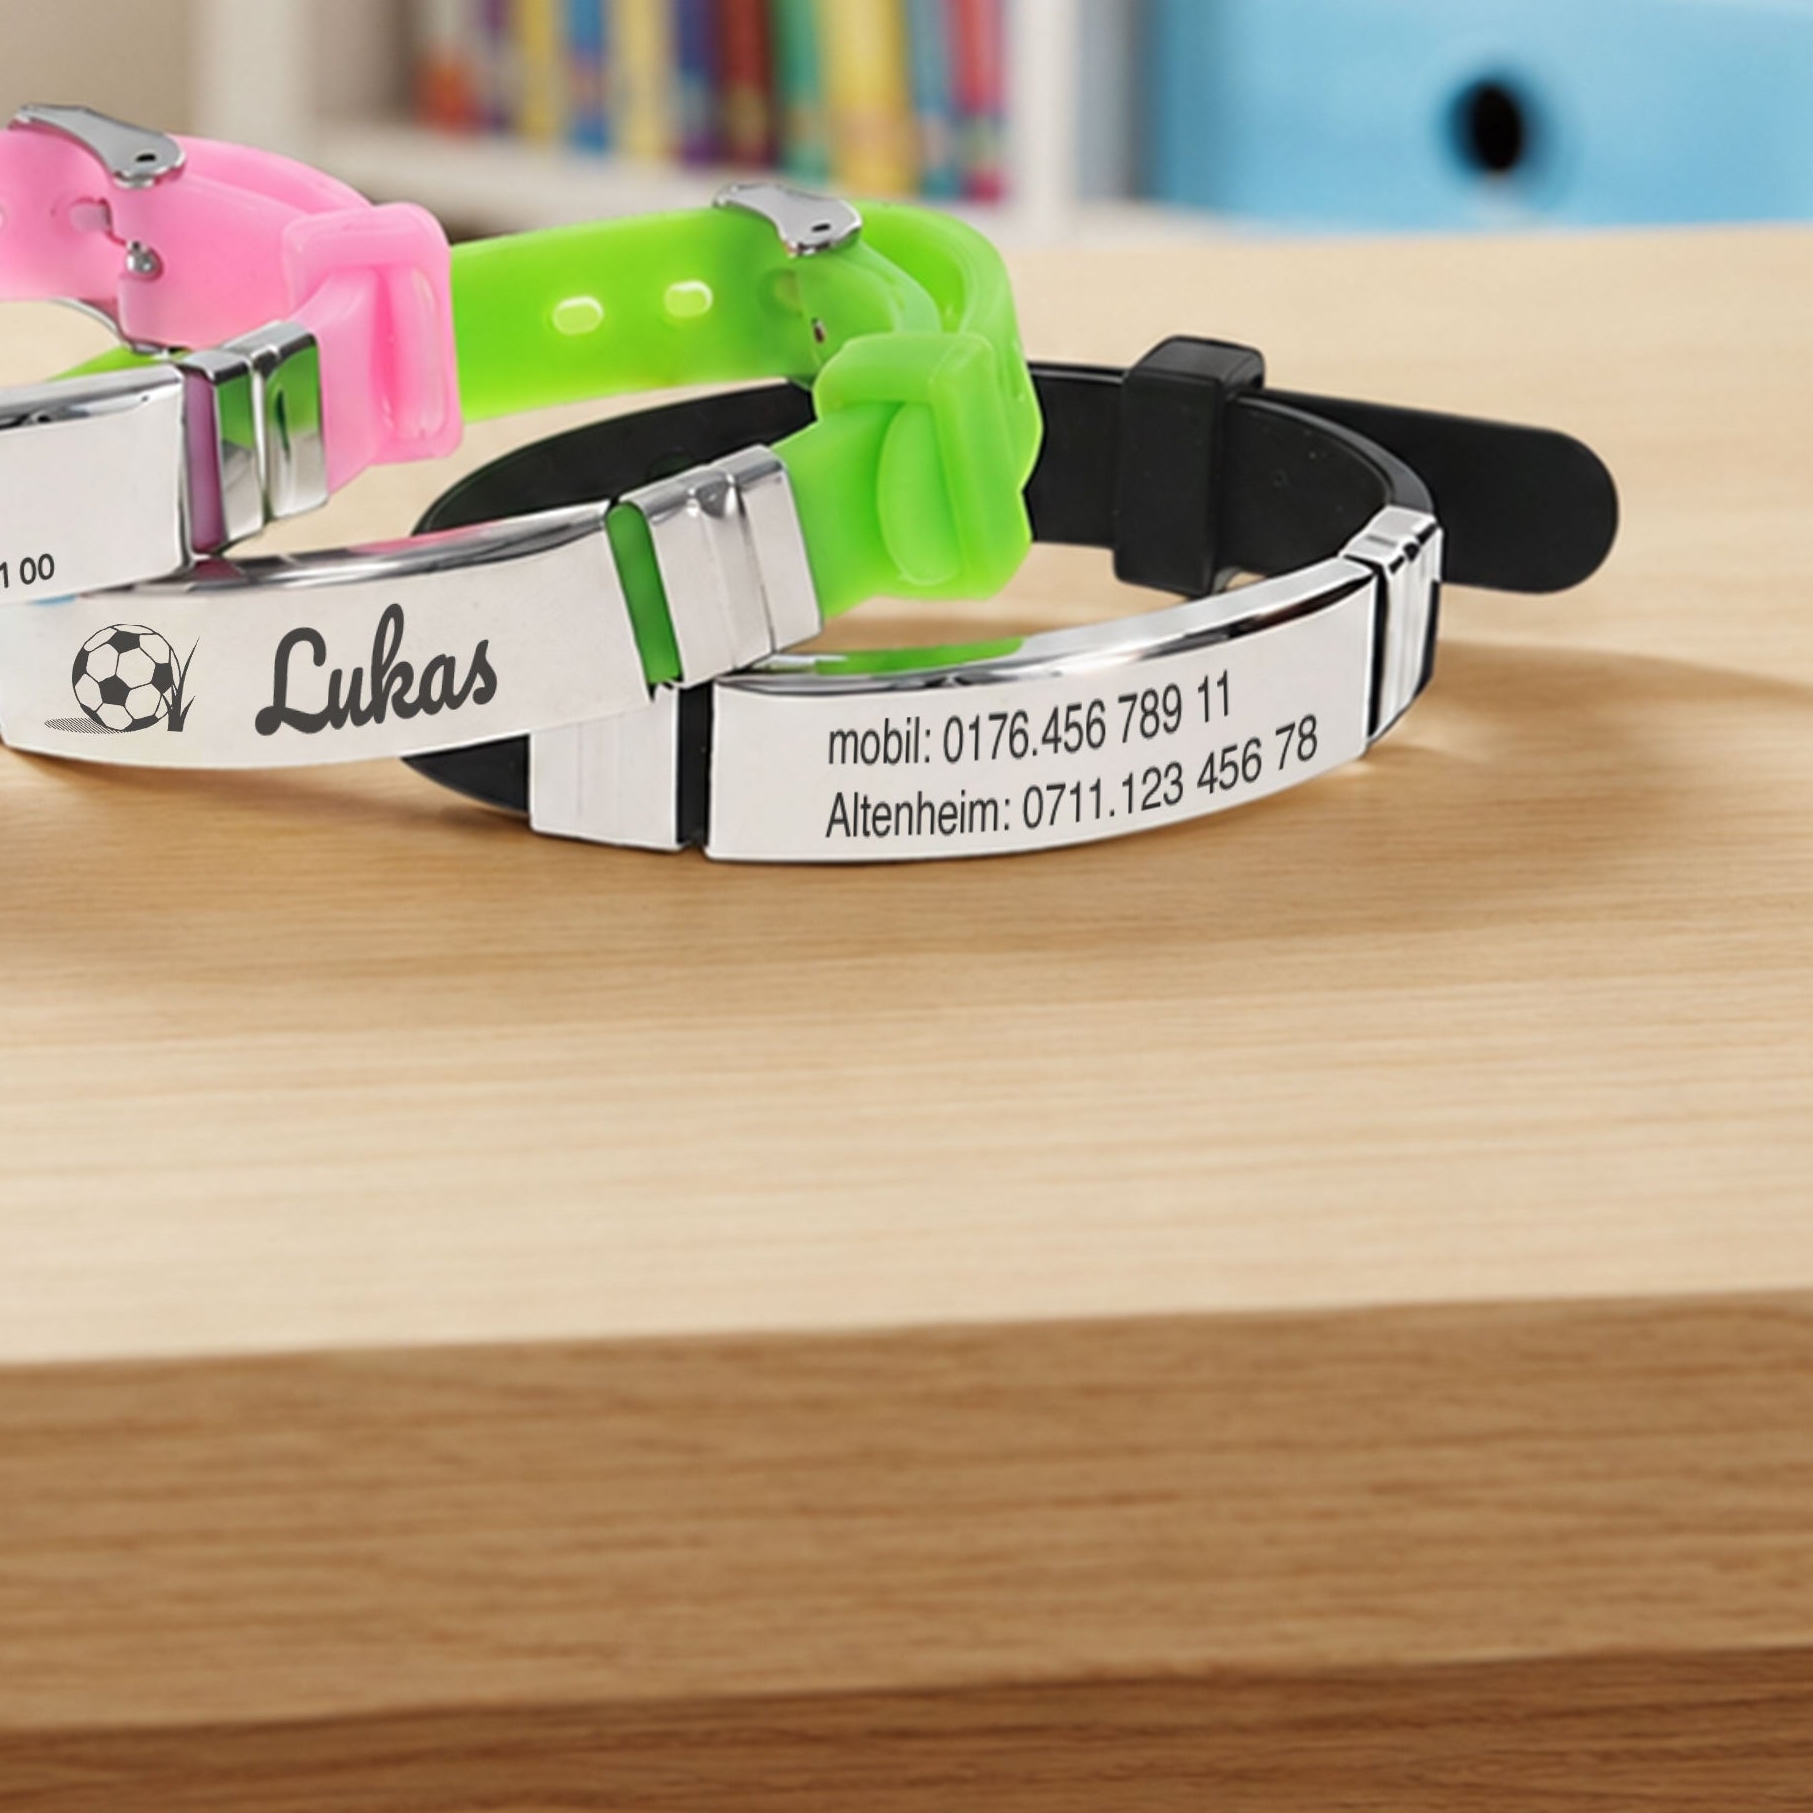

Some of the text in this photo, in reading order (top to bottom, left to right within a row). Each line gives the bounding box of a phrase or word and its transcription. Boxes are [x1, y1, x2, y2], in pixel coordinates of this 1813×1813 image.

[19, 553, 55, 586] 00
[254, 603, 498, 737] Lukas
[828, 669, 1229, 766] mobil: 0176.456 789 11
[825, 714, 1318, 839] Altenheim: 0711.123 456 78
